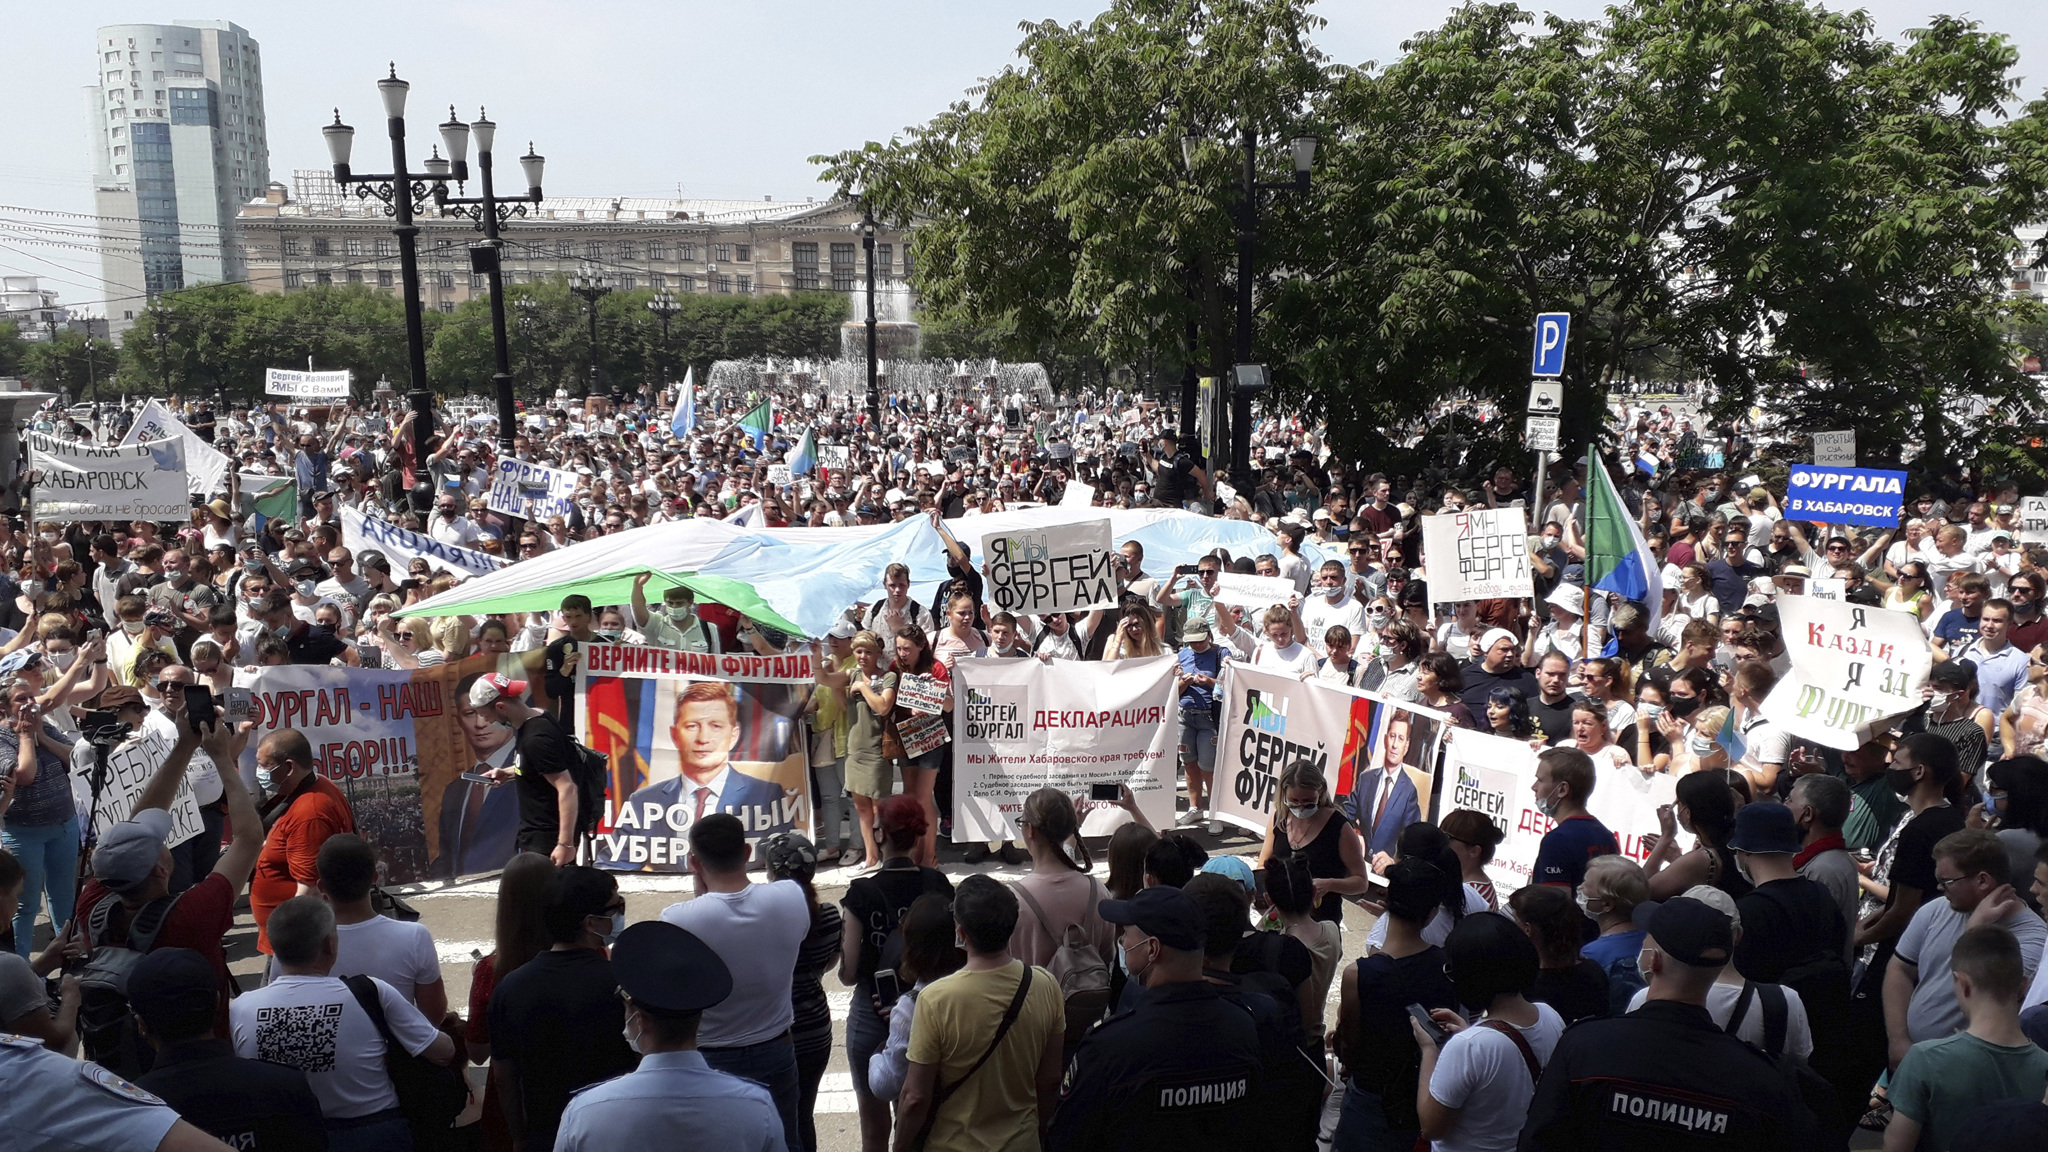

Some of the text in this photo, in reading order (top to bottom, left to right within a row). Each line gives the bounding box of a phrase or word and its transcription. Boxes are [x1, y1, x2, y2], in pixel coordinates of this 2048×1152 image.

[1540, 321, 1560, 366] P
[271, 371, 345, 383] Сергей Иванович
[271, 381, 298, 392] ЯМЫ
[312, 385, 344, 393] Вами!
[37, 471, 148, 490] ХАБАРОВСК
[1791, 471, 1902, 494] ФУРГАЛА
[115, 504, 131, 514] не
[1792, 499, 1894, 517] В ХАБАРОВСК
[1456, 510, 1500, 538] ЯМЫ
[361, 514, 496, 571] АКЦИЯ!!!
[991, 534, 1049, 564] ЯМЫ
[991, 548, 1112, 587] СЕРГЕЙ
[994, 577, 1114, 611] ФУРГАЛ
[1849, 607, 1867, 631] Я
[588, 645, 670, 673] ВЕРНИТЕ
[674, 651, 717, 675] НАМ
[1842, 662, 1911, 698] Я ЗА
[377, 681, 443, 720] НАШ
[966, 702, 1017, 722] СЕРГЕЙ
[1243, 689, 1289, 735] ЯМЫ
[966, 722, 1024, 739] ФУРГАЛ
[1033, 706, 1166, 731] ДЕКЛАРАЦИЯ!
[313, 737, 409, 780] ЫБОР!!!
[967, 749, 1166, 766] МЫ Жители Хабаровского края требуем!
[1235, 767, 1279, 815] ФУР
[1454, 785, 1505, 815] СЕРГЕЙ
[603, 789, 806, 831] АРОНЫЙ
[999, 804, 1024, 813] ЖИТЕ
[1160, 1079, 1246, 1107] ПОЛИЦИЯ
[1612, 1092, 1728, 1134] ПОЛИЦИЯ
